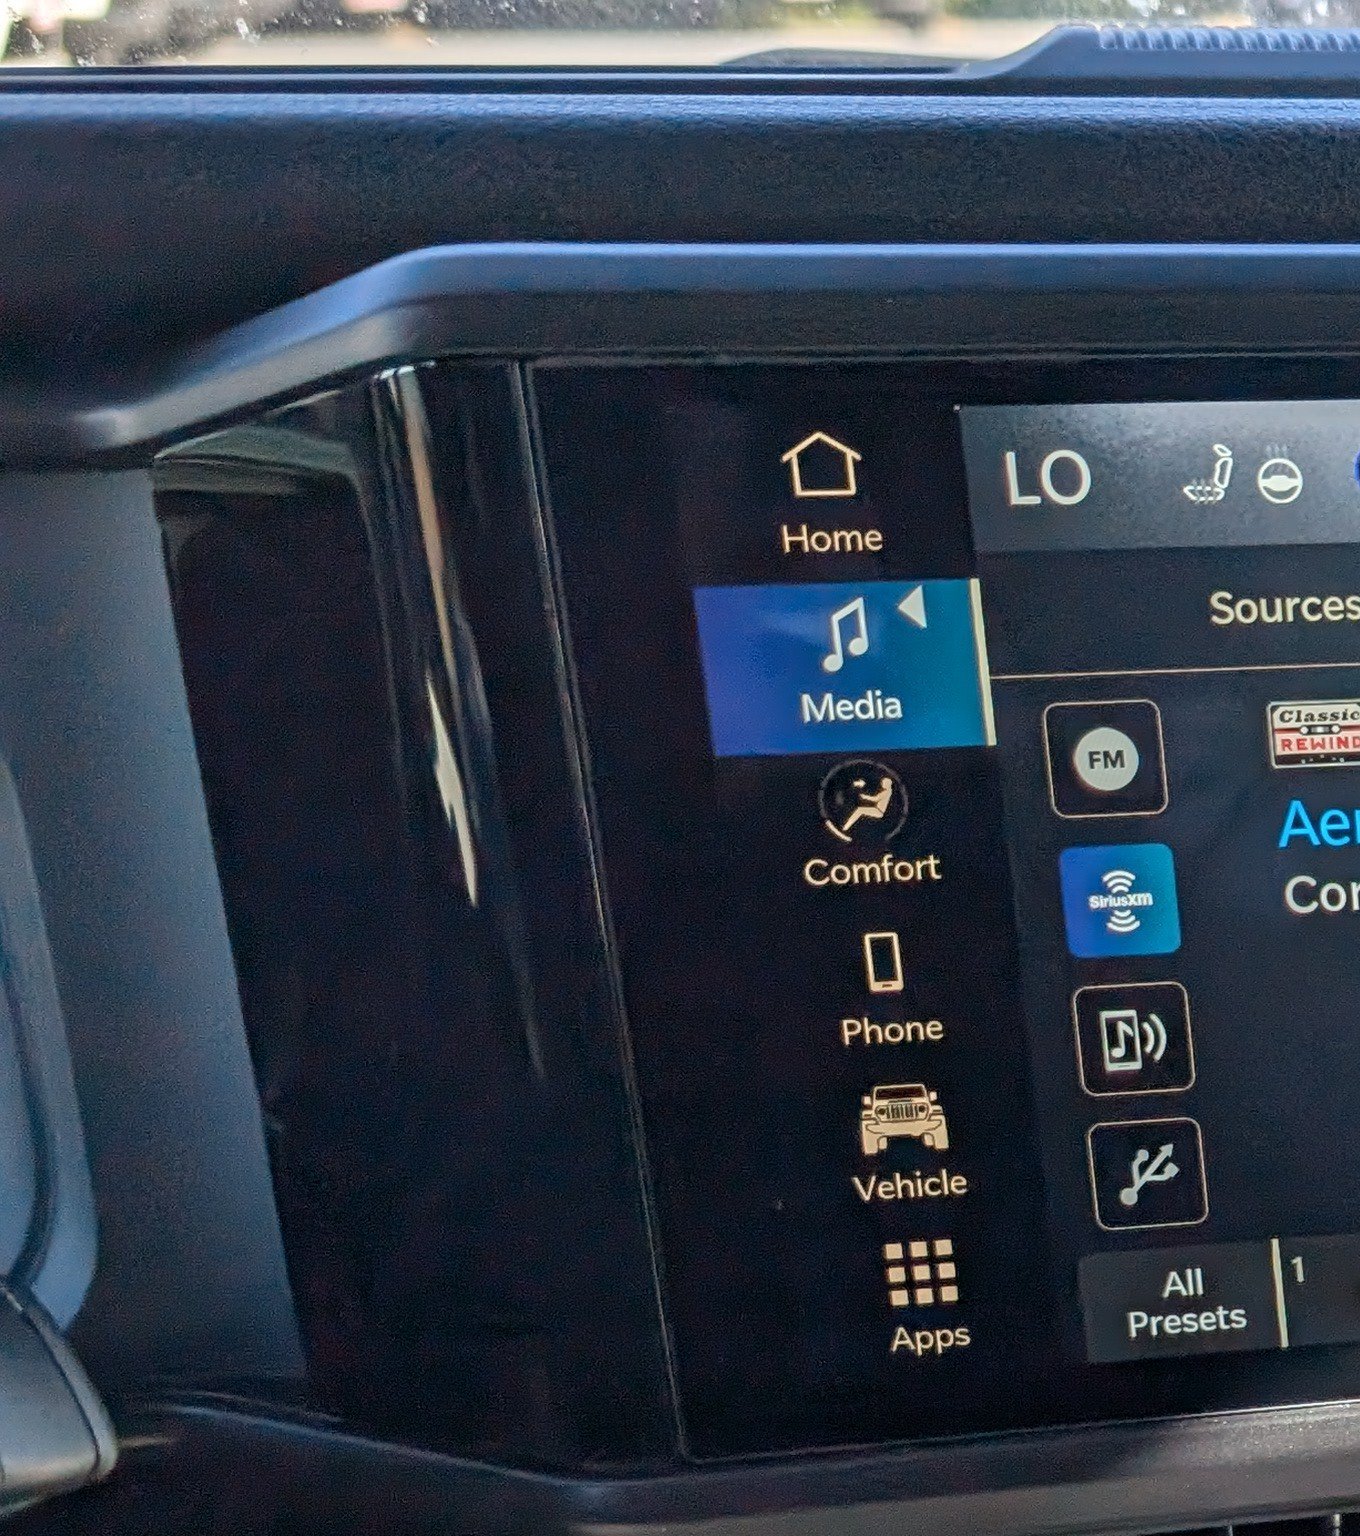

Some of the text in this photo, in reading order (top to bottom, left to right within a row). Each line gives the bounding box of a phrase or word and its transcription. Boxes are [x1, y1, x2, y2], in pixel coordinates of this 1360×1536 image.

[1005, 449, 1091, 506] LO
[781, 523, 884, 553] Home
[800, 691, 903, 723] Media
[1279, 708, 1360, 724] Classic
[1088, 749, 1126, 770] FM
[804, 853, 942, 887] Comfort
[842, 1016, 944, 1047] Phone
[852, 1170, 968, 1202] Vehicle
[1163, 1267, 1204, 1298] All
[1290, 1256, 1305, 1283] 1
[1127, 1305, 1247, 1339] Presets
[891, 1325, 972, 1355] Apps
